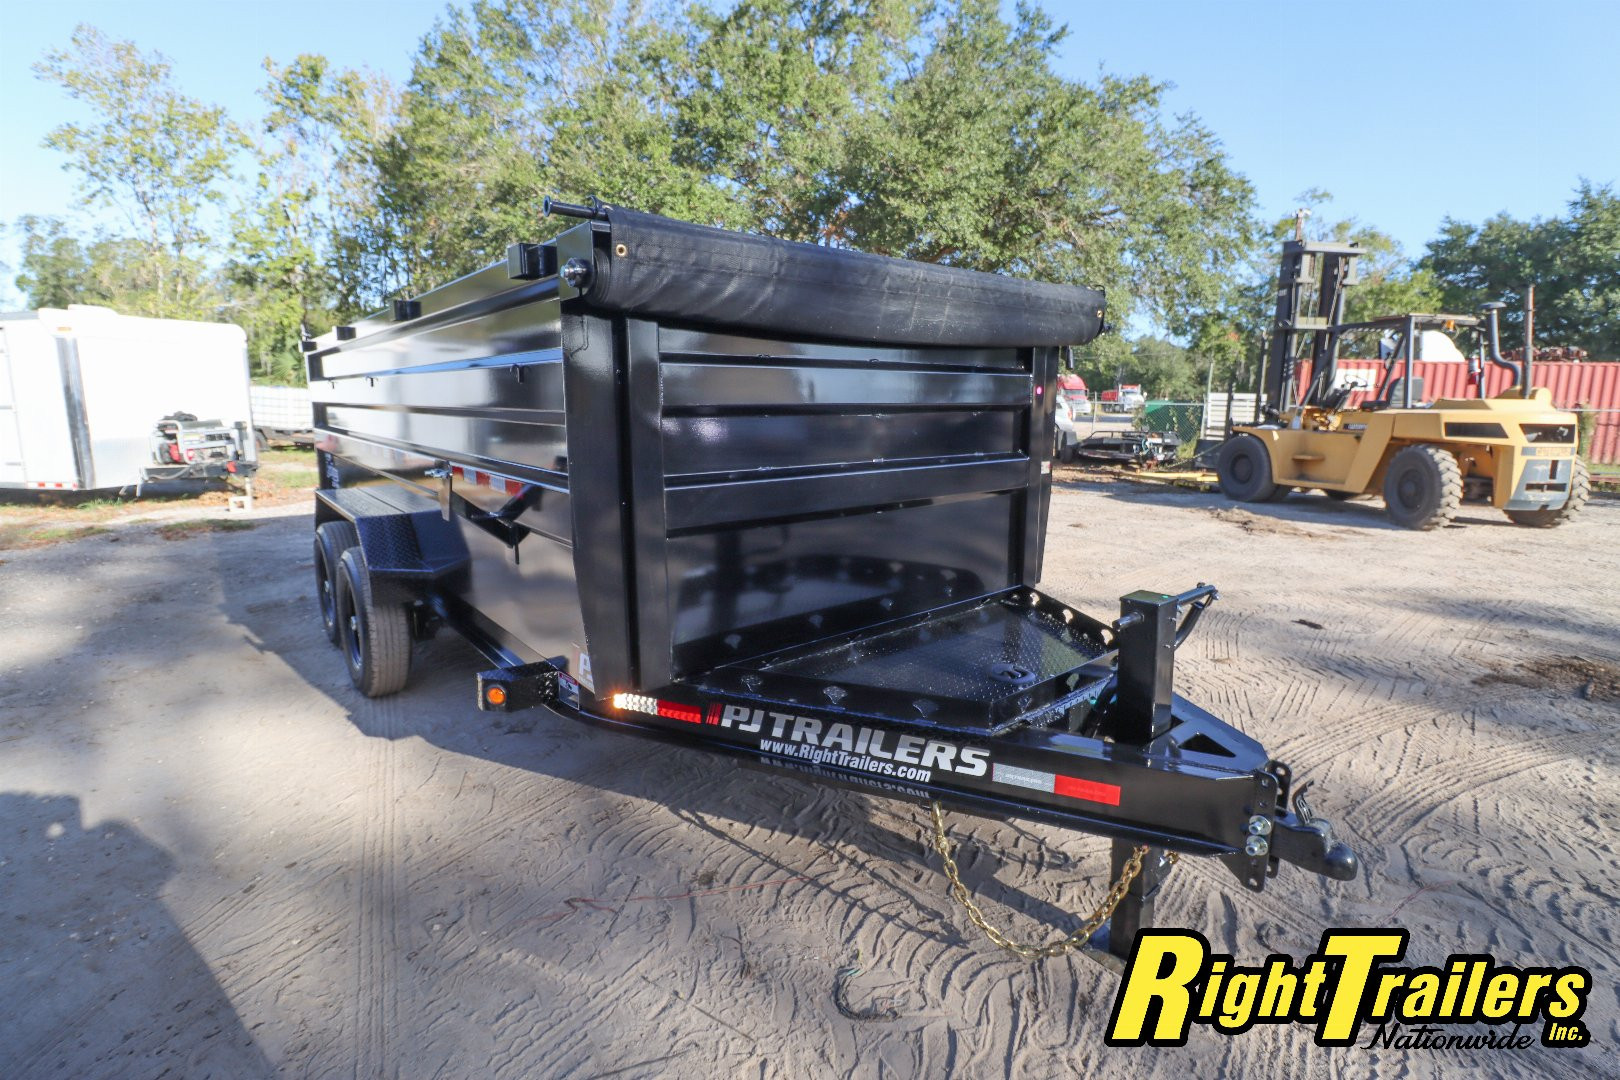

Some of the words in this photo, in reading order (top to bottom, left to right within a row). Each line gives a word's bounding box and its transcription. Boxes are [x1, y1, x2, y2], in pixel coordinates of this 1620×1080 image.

[721, 704, 765, 733] PJ
[769, 711, 991, 778] TRAILERS
[760, 739, 932, 783] www.RightTrailers.com
